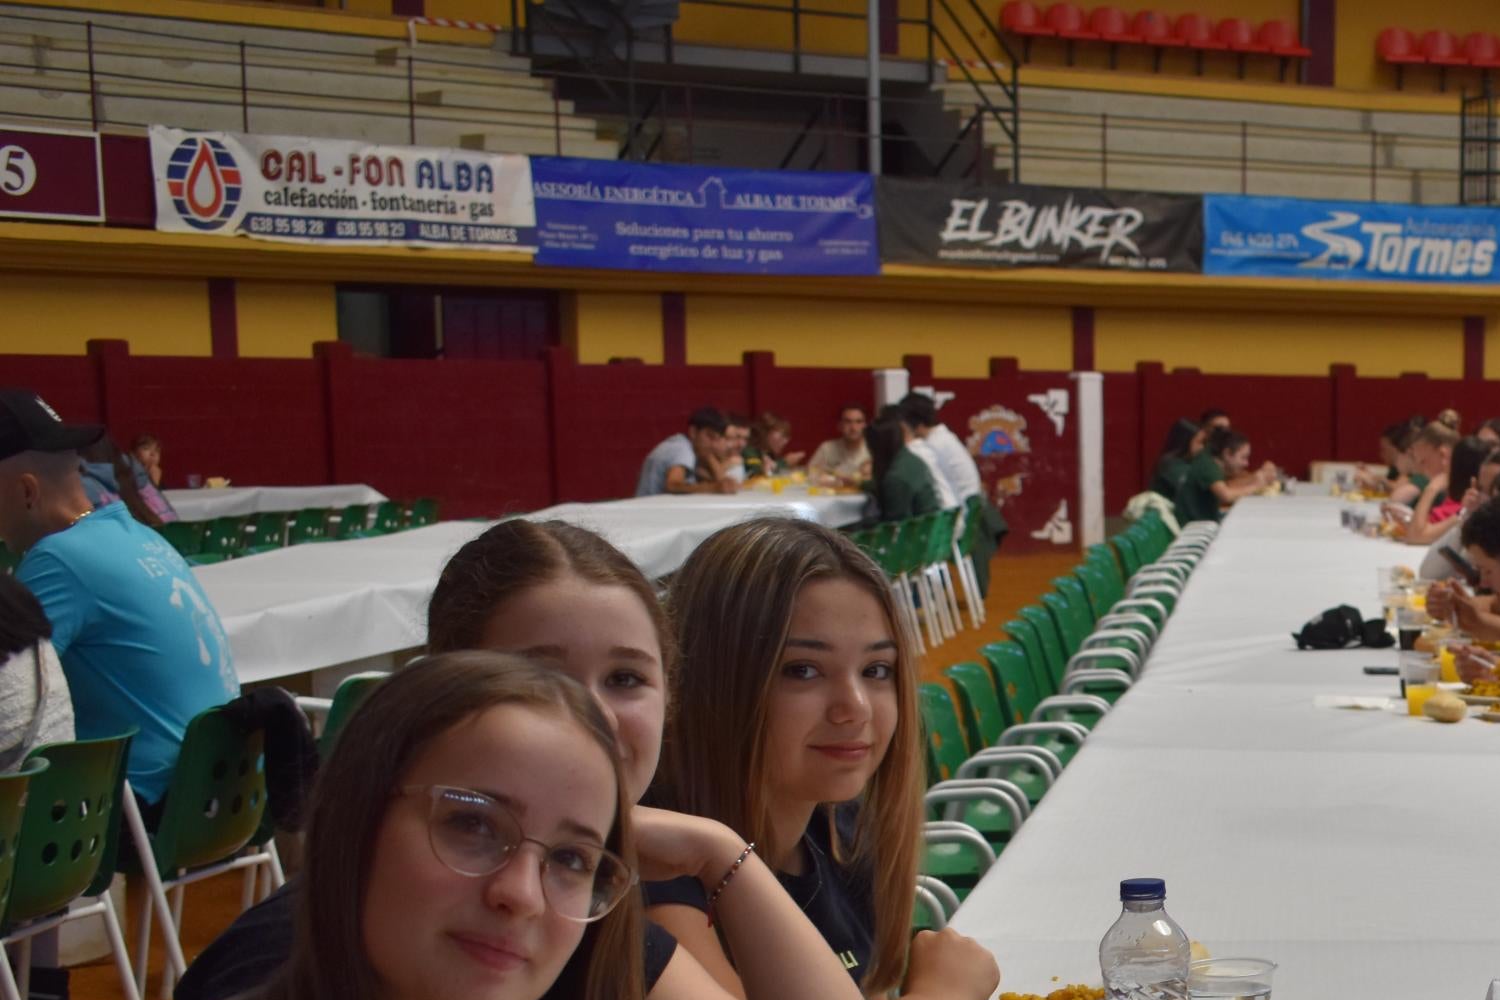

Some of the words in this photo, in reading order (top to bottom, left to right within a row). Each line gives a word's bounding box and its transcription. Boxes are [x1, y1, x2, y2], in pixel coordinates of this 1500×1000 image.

[4, 150, 25, 191] 5
[260, 149, 326, 184] CAL
[415, 158, 494, 194] ALBA
[263, 187, 358, 211] calefacción
[469, 202, 495, 221] gas
[534, 181, 601, 201] ASESORÍA
[604, 185, 695, 205] ENERGÉTICA
[419, 223, 448, 240] ALBA
[451, 225, 467, 241] DE
[468, 226, 518, 244] TORMES
[615, 221, 690, 239] Soluciones
[692, 228, 725, 243] para
[727, 228, 743, 241] tu
[747, 227, 794, 242] ahorro
[939, 198, 993, 243] EL
[985, 193, 1143, 261] BUNKER
[629, 243, 699, 260] energético
[702, 245, 719, 259] de
[720, 246, 744, 260] luz
[745, 249, 755, 263] y
[758, 249, 784, 265] gas
[1360, 221, 1498, 276] Tormes
